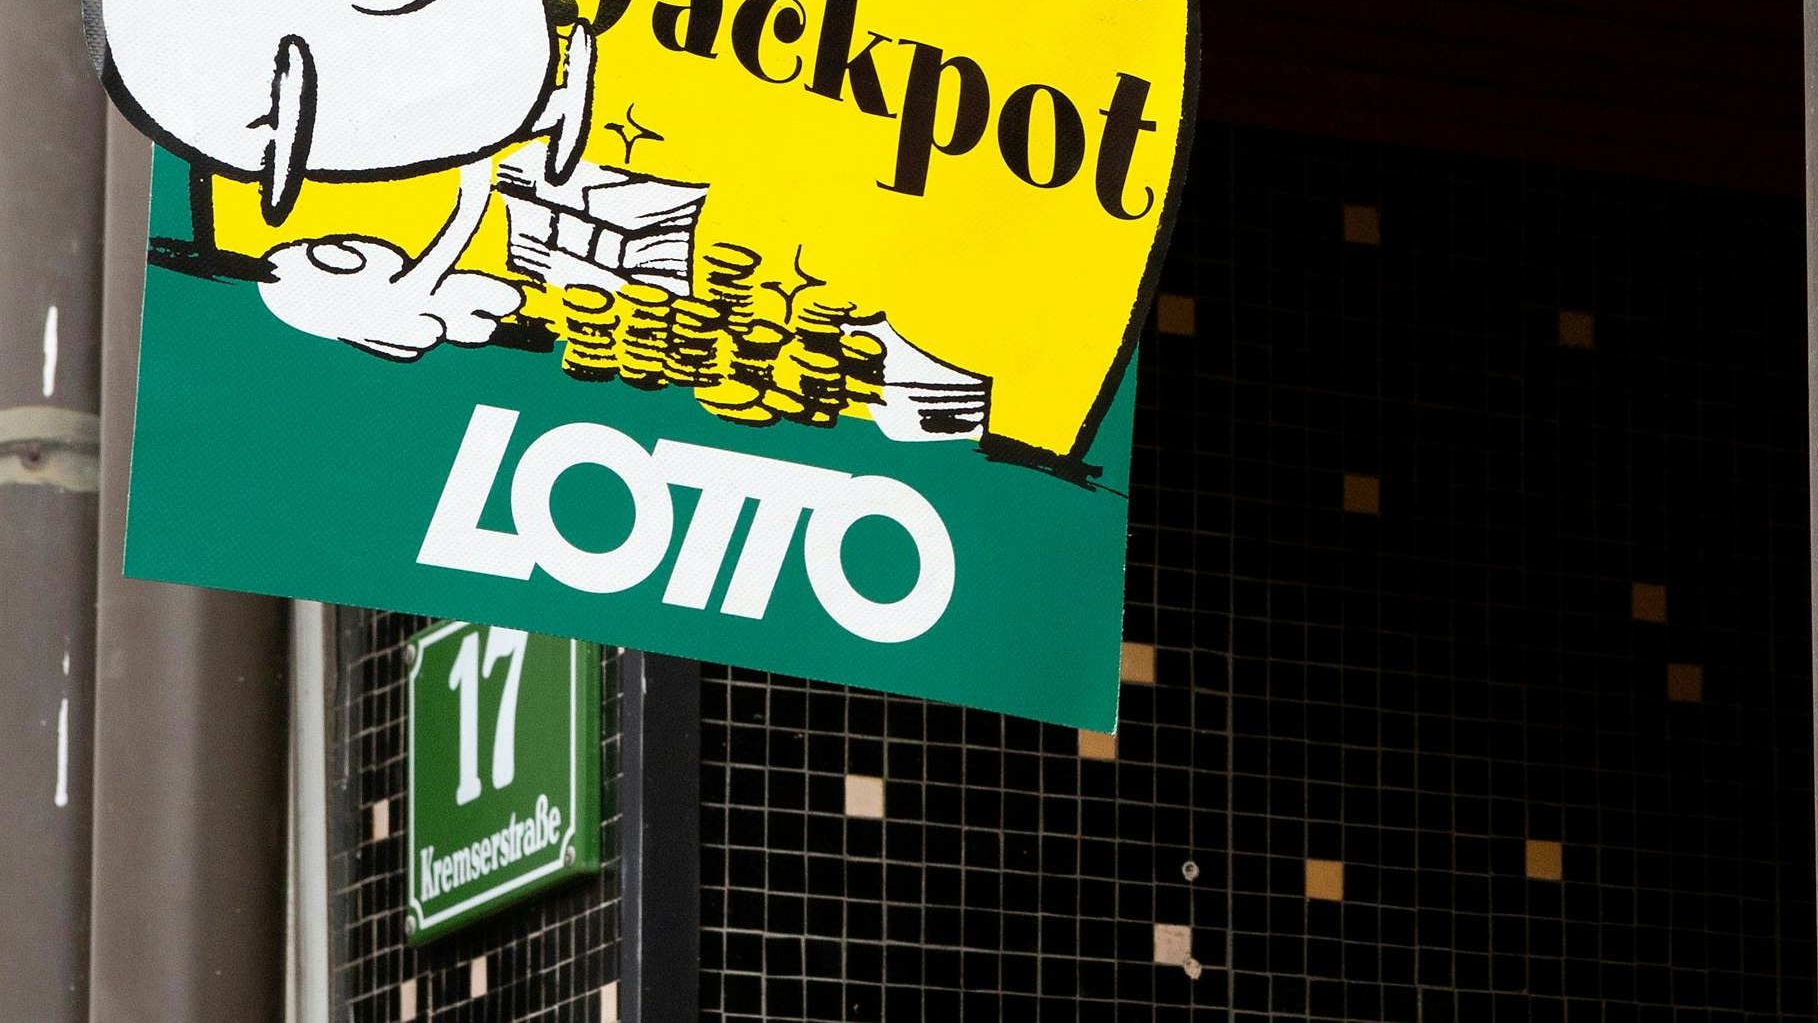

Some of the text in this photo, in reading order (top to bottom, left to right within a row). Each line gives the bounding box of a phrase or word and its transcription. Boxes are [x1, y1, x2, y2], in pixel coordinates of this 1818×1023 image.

[415, 404, 956, 644] LOTTO
[449, 626, 529, 806] 17
[420, 794, 562, 903] Kremserstraße
